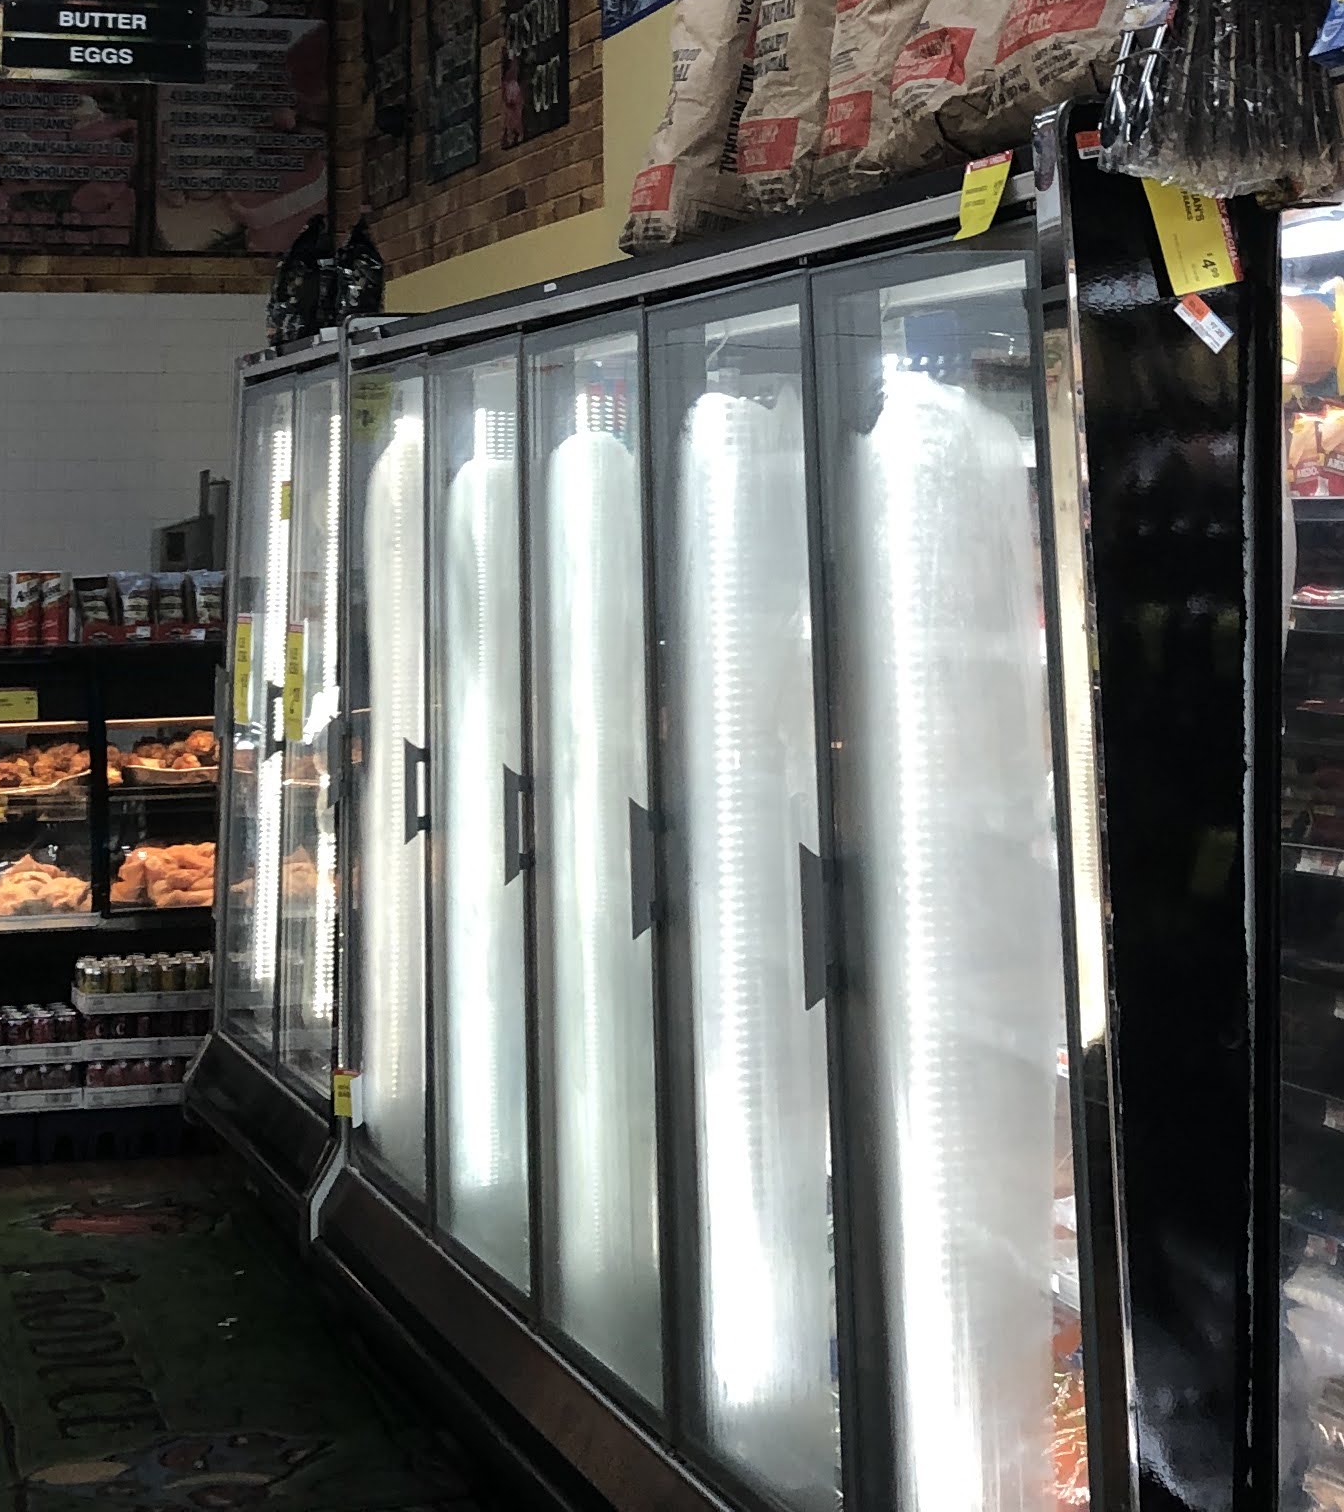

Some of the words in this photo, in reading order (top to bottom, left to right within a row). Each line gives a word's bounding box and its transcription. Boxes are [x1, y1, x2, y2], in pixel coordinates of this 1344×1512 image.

[59, 11, 147, 31] BUTTER
[70, 46, 133, 65] EGGS
[719, 98, 749, 174] NATURAL
[34, 168, 90, 180] SHOULDER
